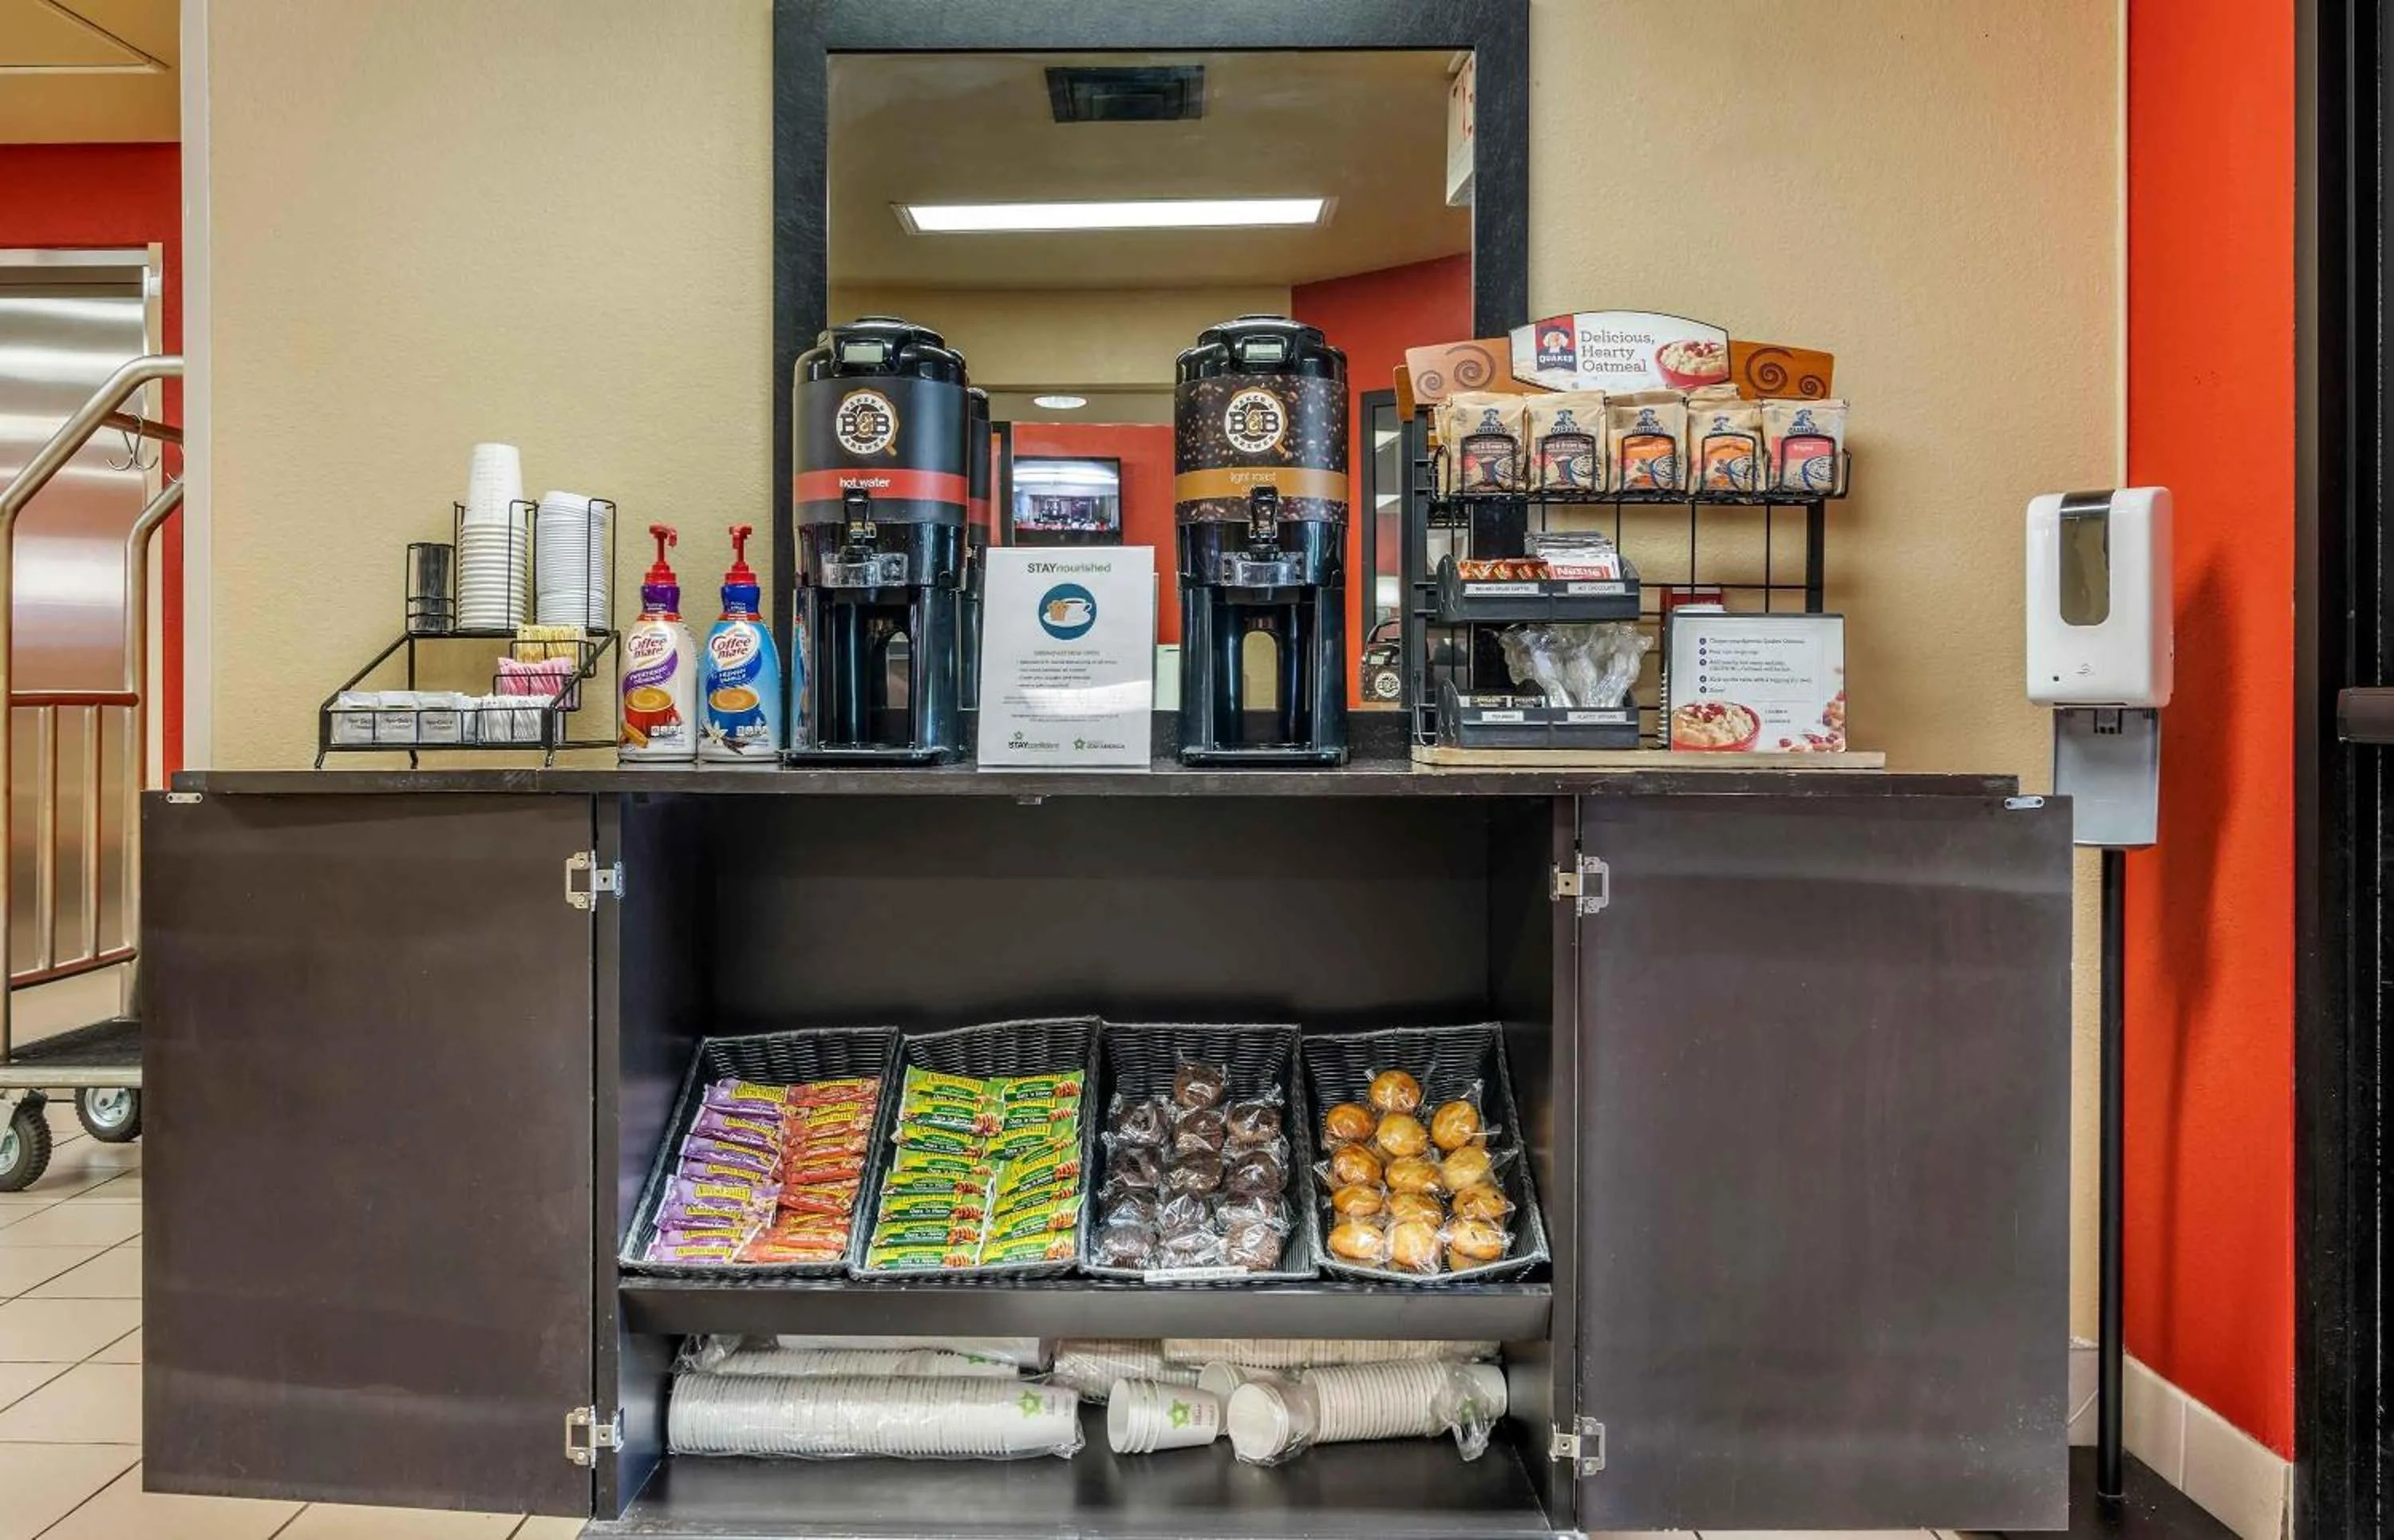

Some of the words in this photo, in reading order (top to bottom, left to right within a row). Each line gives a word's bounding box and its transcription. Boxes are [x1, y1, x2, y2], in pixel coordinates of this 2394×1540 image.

[1580, 330, 1656, 345] Delicious,
[1582, 346, 1635, 359] Hearty
[1539, 354, 1574, 365] QUAKER
[1582, 360, 1648, 373] Oatmeal
[840, 412, 890, 437] B&B
[1229, 411, 1279, 435] B&B
[839, 476, 857, 488] hot
[858, 477, 891, 488] water
[1027, 562, 1112, 574] STAYnourished
[629, 635, 668, 653] Coffee
[711, 636, 753, 652] Coffee
[634, 647, 664, 658] mate
[718, 646, 749, 659] mate
